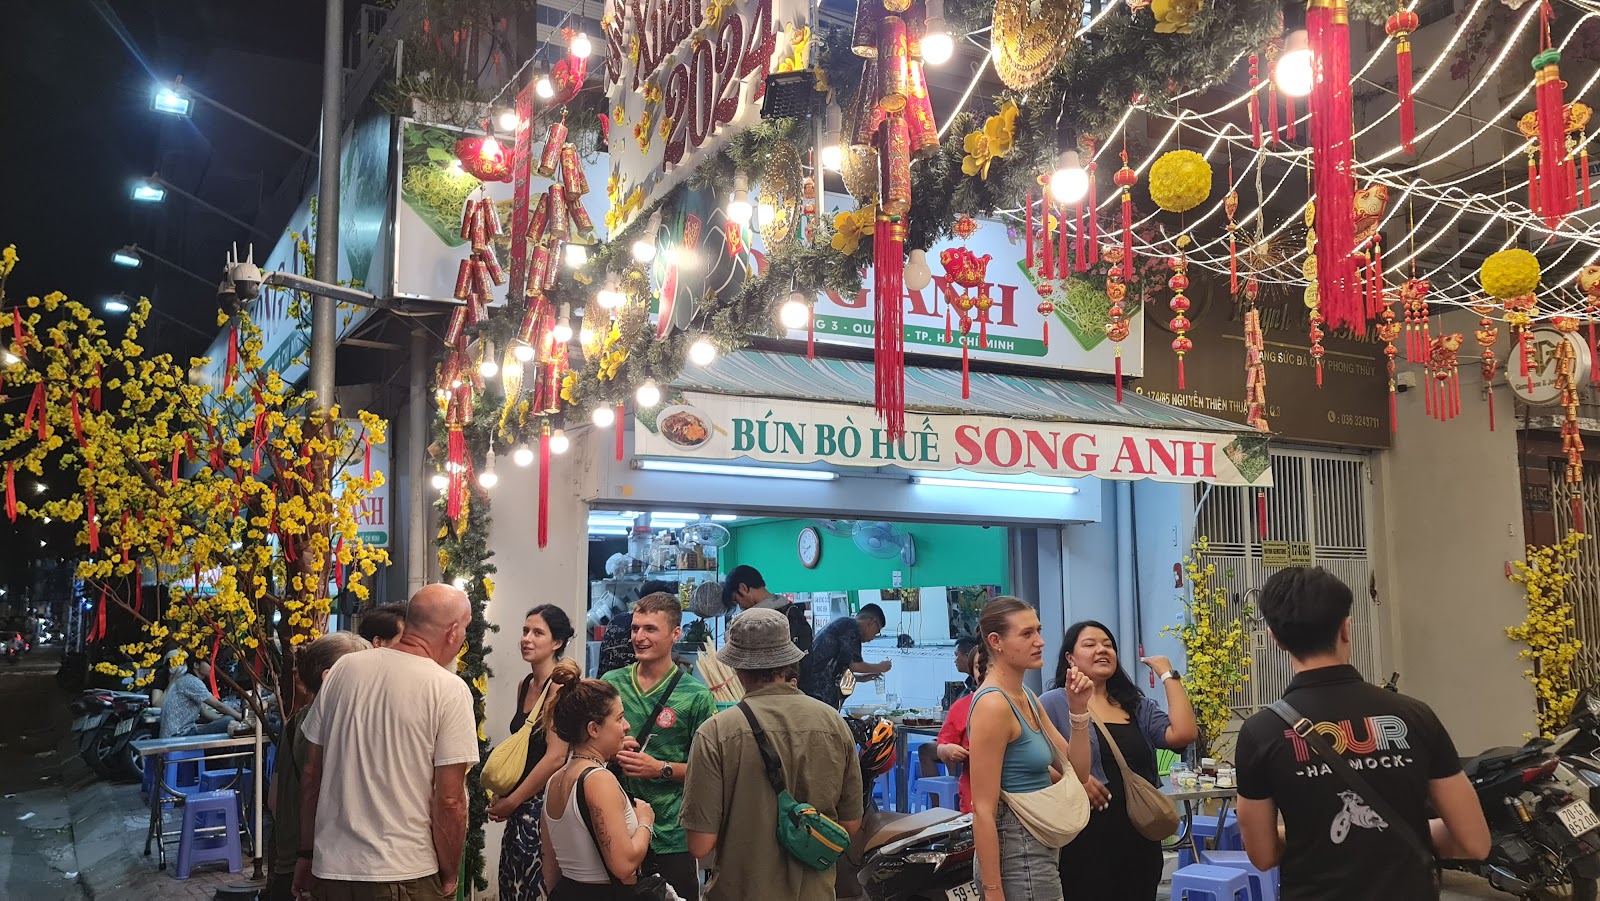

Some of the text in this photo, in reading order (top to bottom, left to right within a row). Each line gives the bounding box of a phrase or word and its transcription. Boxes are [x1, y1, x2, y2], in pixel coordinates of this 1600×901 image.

[664, 0, 778, 172] 2024
[831, 322, 839, 331] 3
[915, 330, 932, 342] TP.
[958, 335, 979, 347] CHÍ
[985, 340, 1014, 351] MINH
[1328, 360, 1355, 373] PHONG
[1147, 391, 1170, 405] 174/85
[1171, 390, 1204, 409] NGUYỄN
[1205, 396, 1228, 414] THIỆN
[1229, 400, 1249, 416] THUẬ
[731, 409, 1217, 478] BÚN BÒ HUẾ SONG ANH
[1291, 544, 1310, 556] 174/85
[1284, 714, 1411, 762] TOUR
[1295, 754, 1414, 778] -HAMOCK-
[1568, 813, 1599, 835] 852.00
